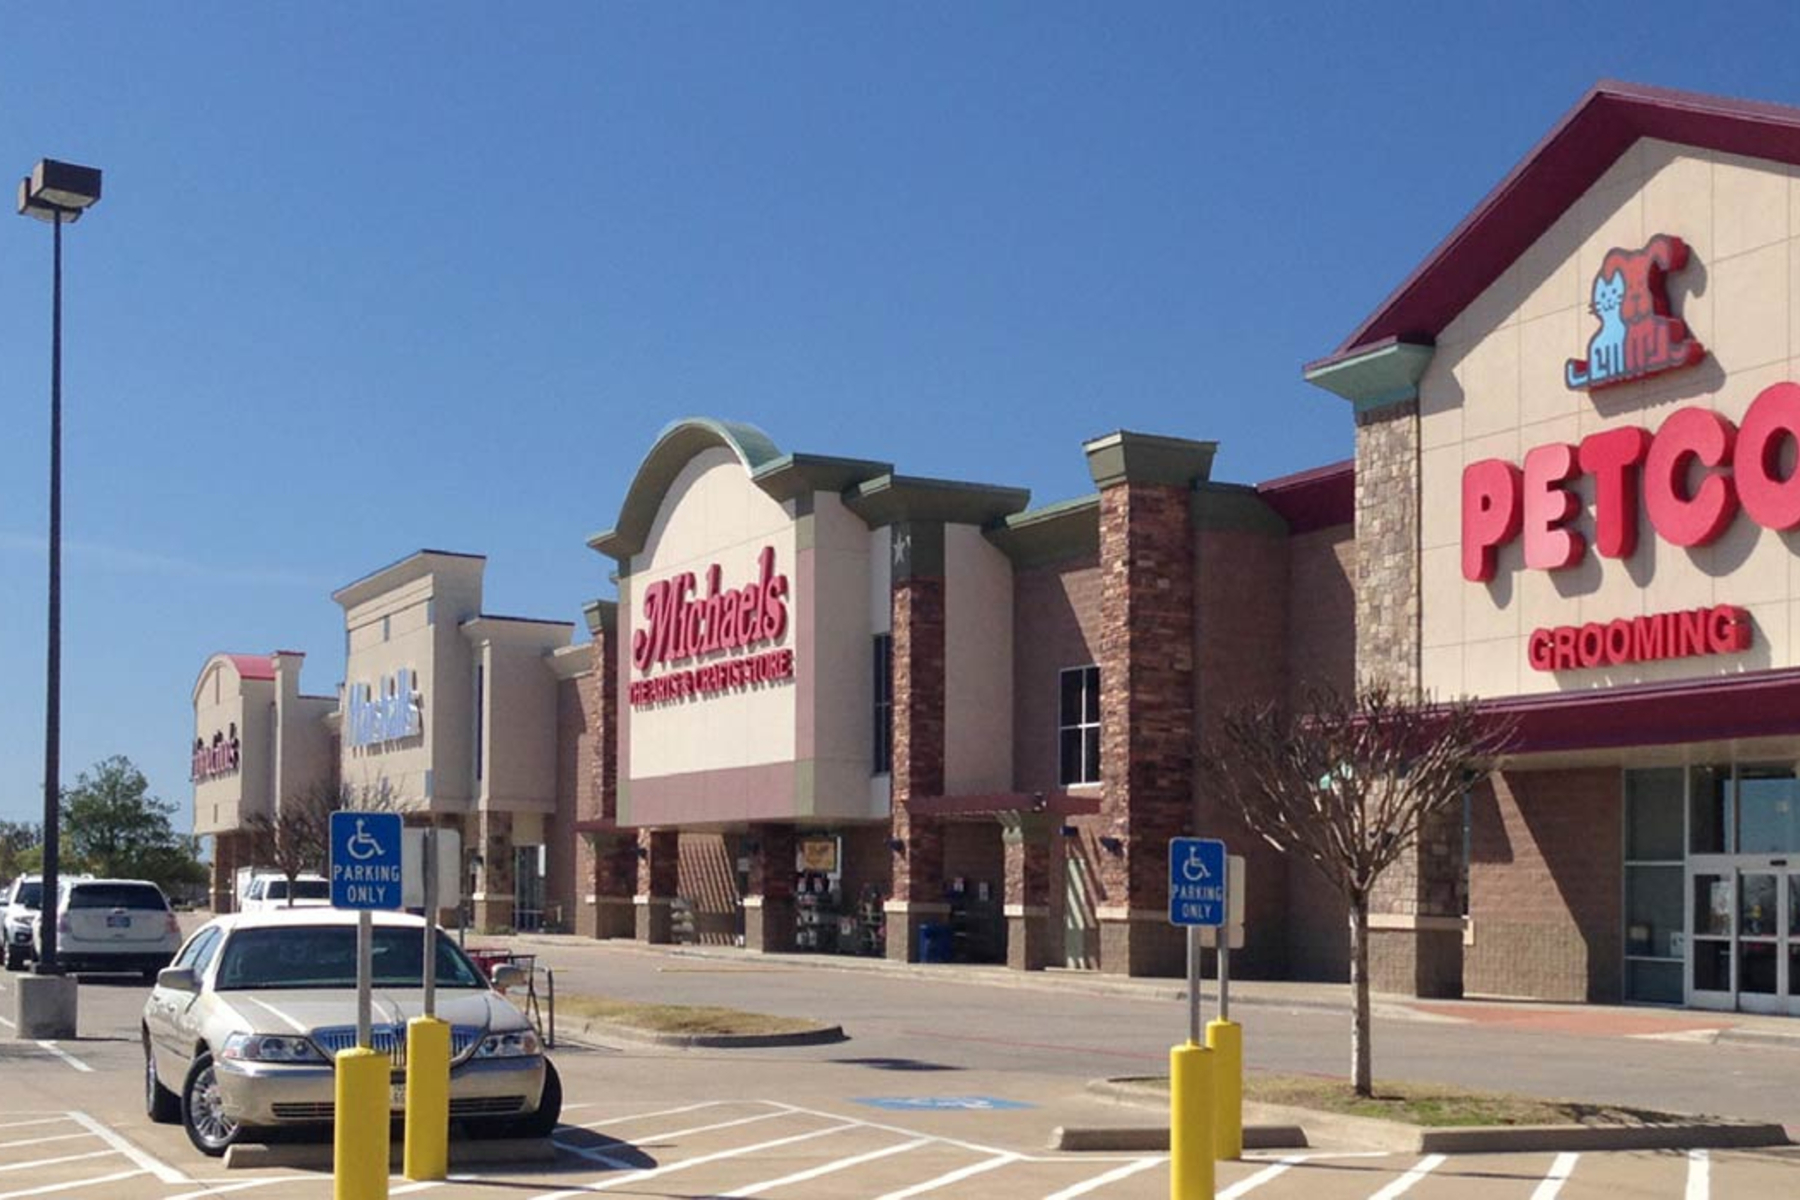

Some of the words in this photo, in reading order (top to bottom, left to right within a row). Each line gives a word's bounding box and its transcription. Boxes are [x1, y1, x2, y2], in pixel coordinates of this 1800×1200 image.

[1461, 382, 1800, 582] PETCO
[633, 546, 790, 671] Michaels
[1528, 604, 1752, 672] GROOMING
[744, 649, 794, 682] STORE
[333, 864, 400, 882] PARKING
[346, 884, 387, 903] ONLY
[1171, 884, 1223, 902] PARKING
[1181, 903, 1213, 919] ONLY
